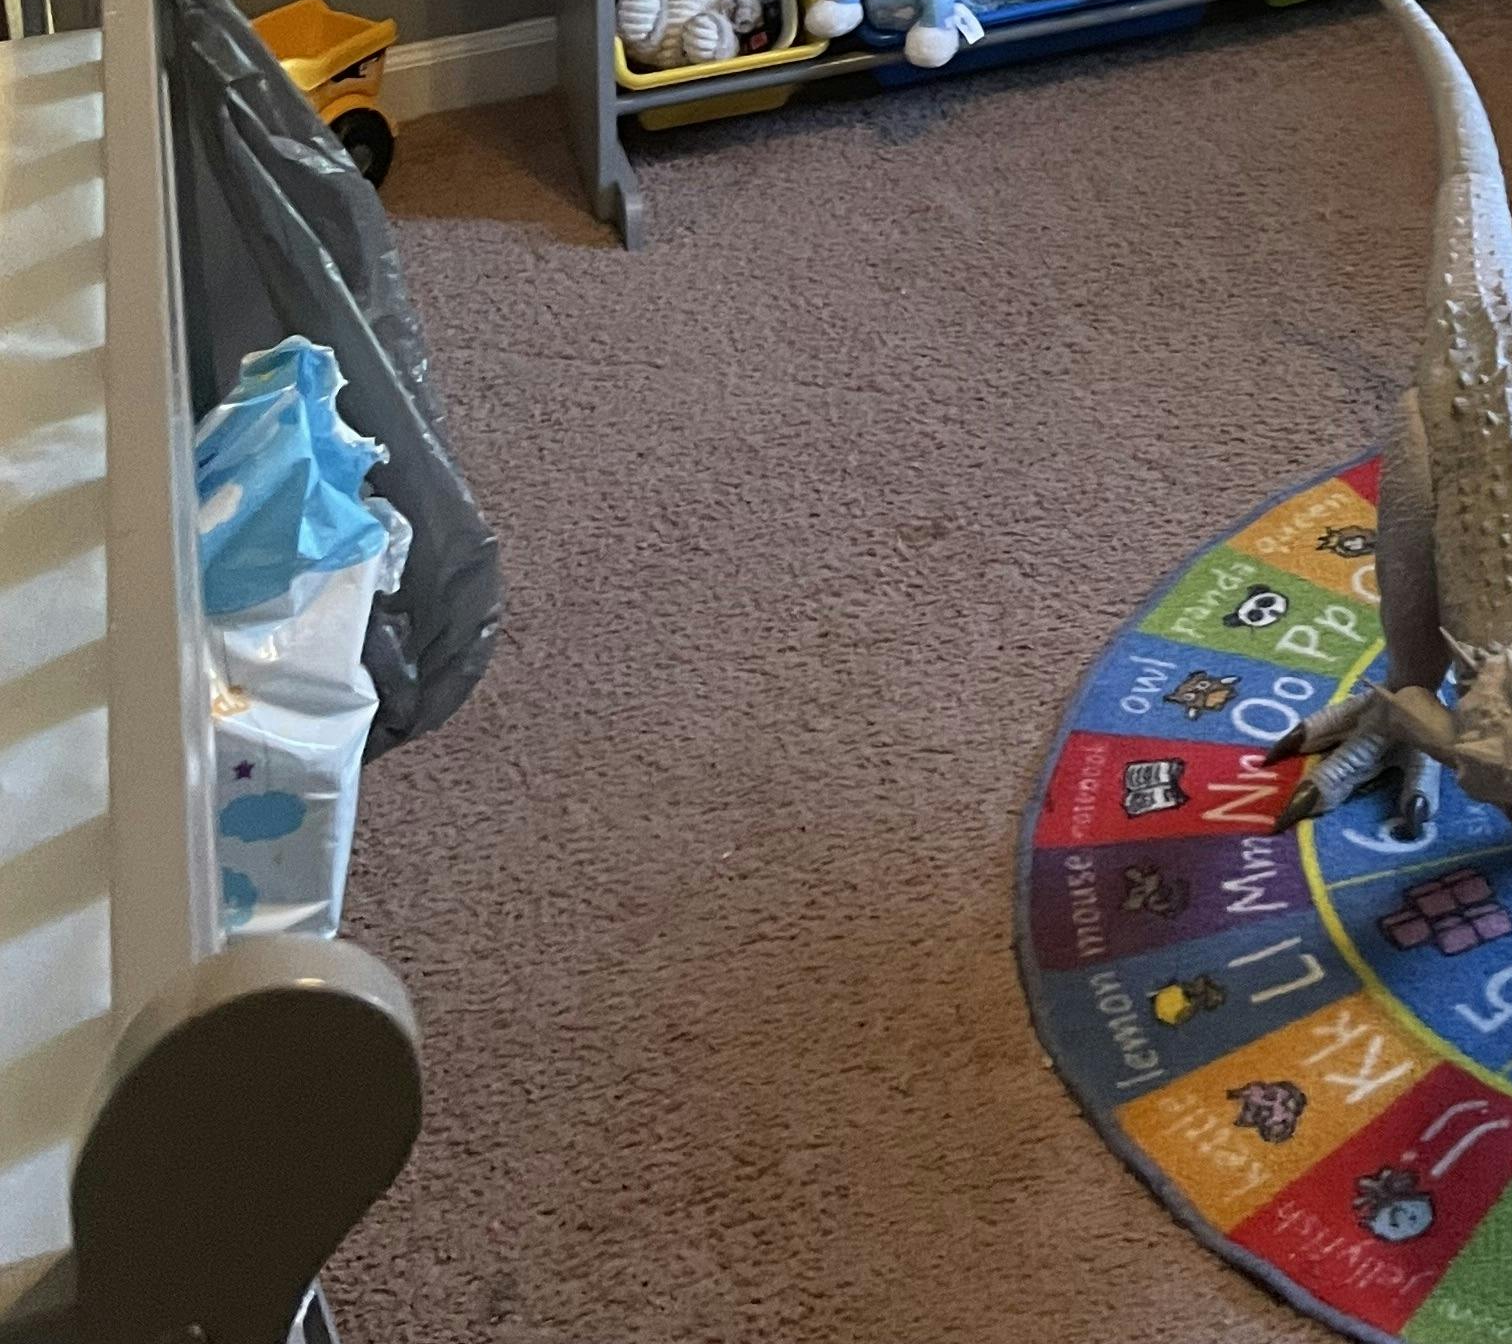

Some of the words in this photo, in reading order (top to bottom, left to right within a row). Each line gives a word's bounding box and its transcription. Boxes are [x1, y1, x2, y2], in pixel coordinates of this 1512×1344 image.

[1171, 563, 1257, 640] panda
[1276, 606, 1367, 663] Pp
[1120, 656, 1177, 714] owl
[1232, 677, 1315, 741] Oo
[1202, 754, 1280, 825] Nn
[1064, 854, 1107, 957] mouse
[1222, 836, 1288, 912] Mm
[1090, 970, 1165, 1089] lemon
[1304, 1011, 1415, 1105] Kk
